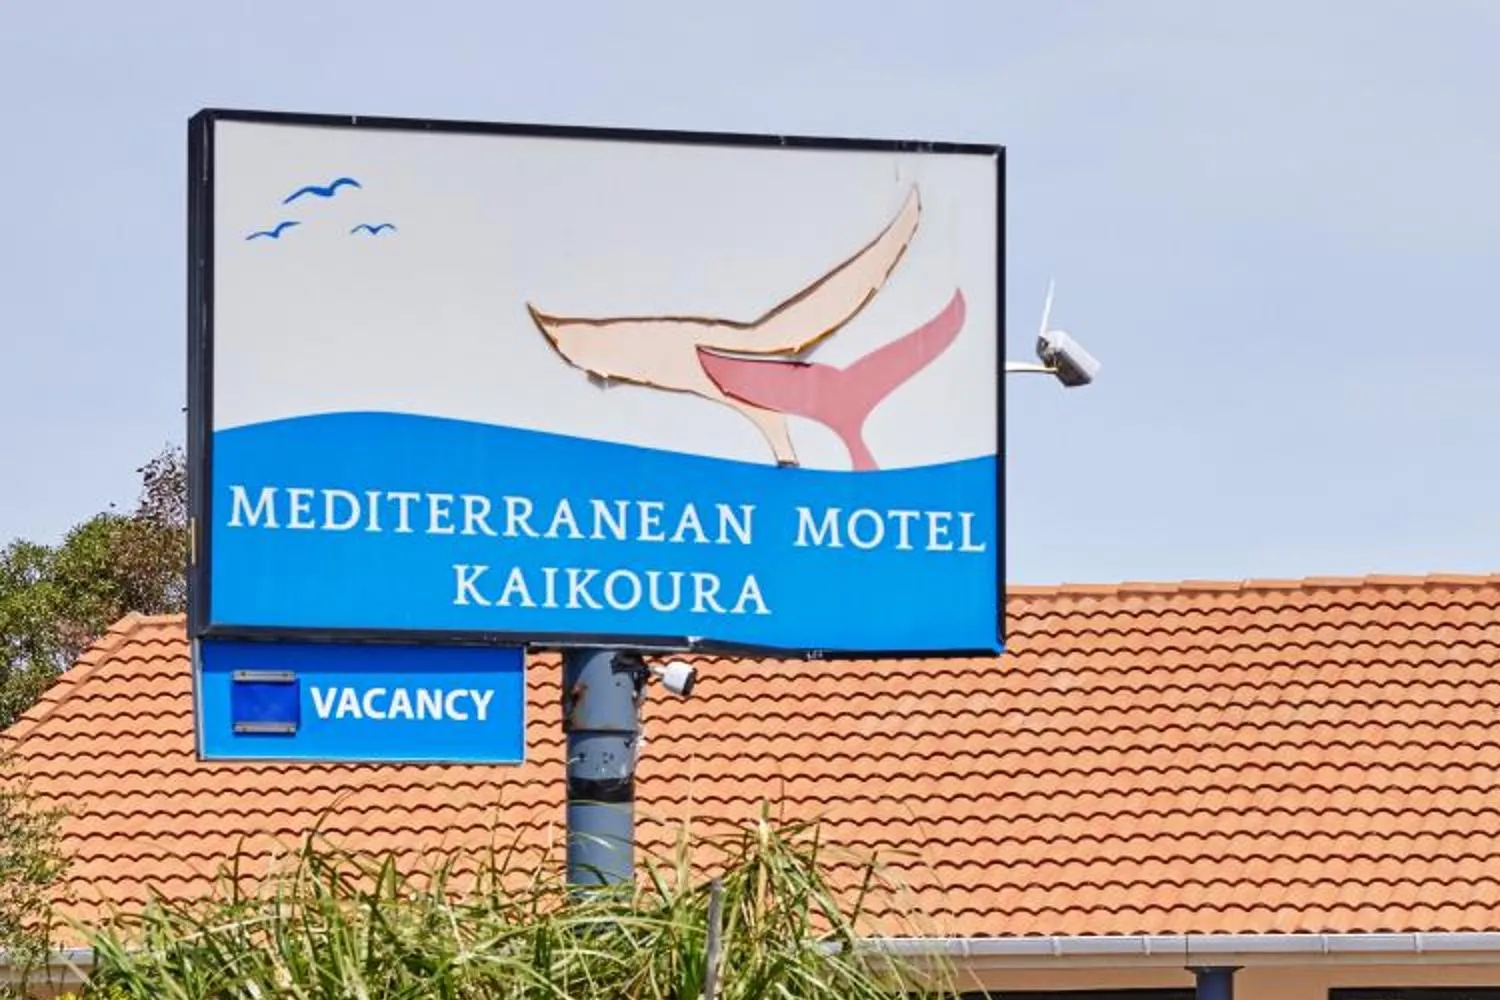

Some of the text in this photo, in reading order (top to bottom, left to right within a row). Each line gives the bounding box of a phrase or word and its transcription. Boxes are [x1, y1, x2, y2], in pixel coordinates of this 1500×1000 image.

[228, 485, 986, 552] MEDITERRANEAN MOTEL
[453, 564, 770, 615] KAIKOURA
[309, 687, 495, 721] VACANCY
